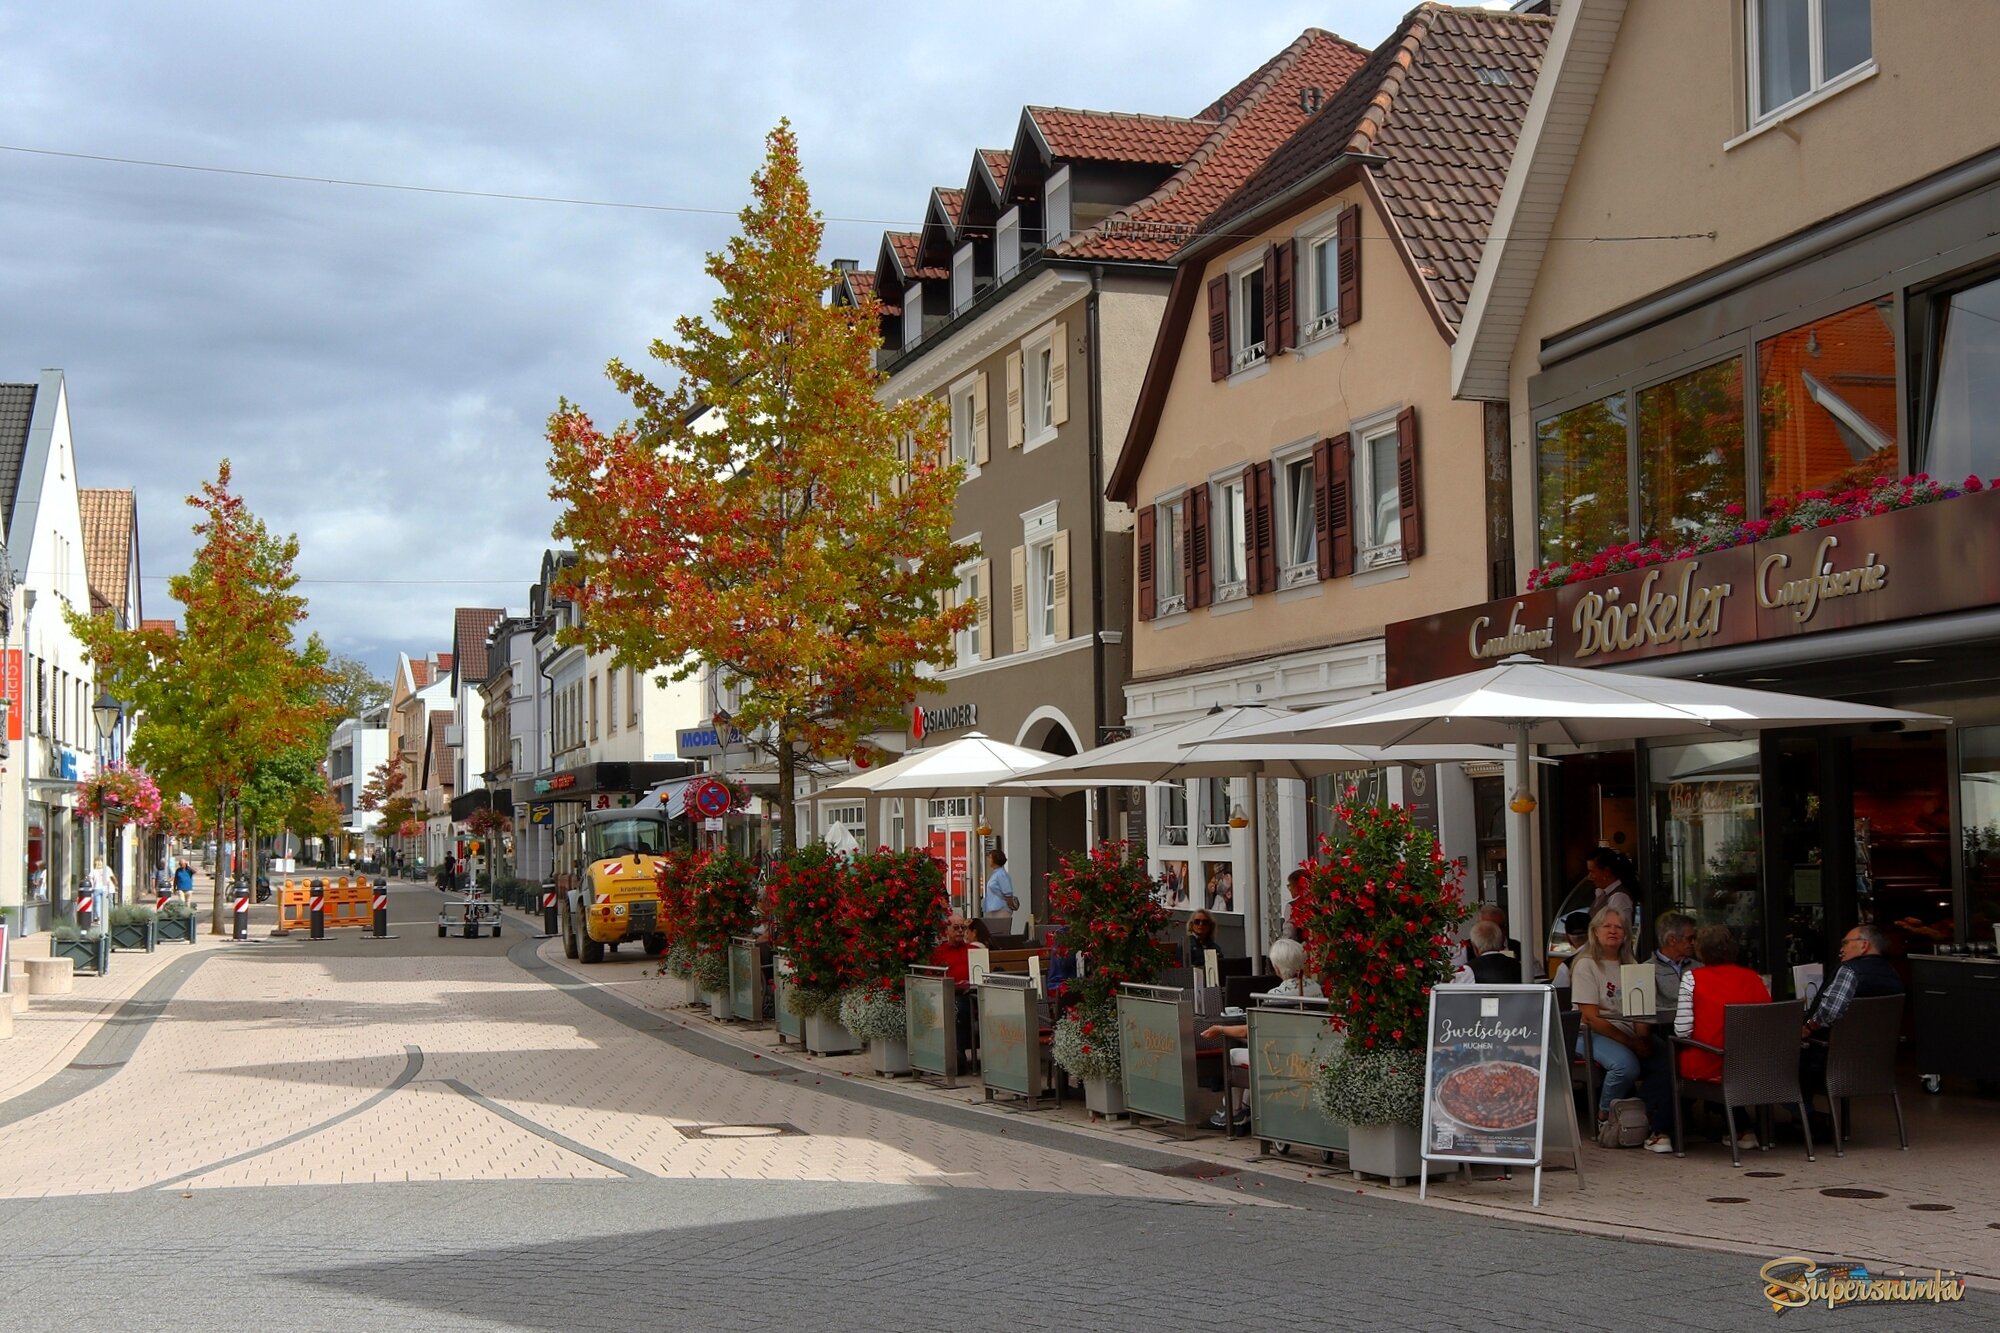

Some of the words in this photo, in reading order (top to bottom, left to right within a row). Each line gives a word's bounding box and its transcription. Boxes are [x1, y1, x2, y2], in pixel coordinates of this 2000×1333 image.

[1573, 561, 1731, 658] Böckeler
[1756, 536, 1886, 623] Confiserie
[922, 703, 976, 733] OSIANDER
[615, 906, 625, 915] 20
[1462, 1042, 1494, 1050] KUCHEN
